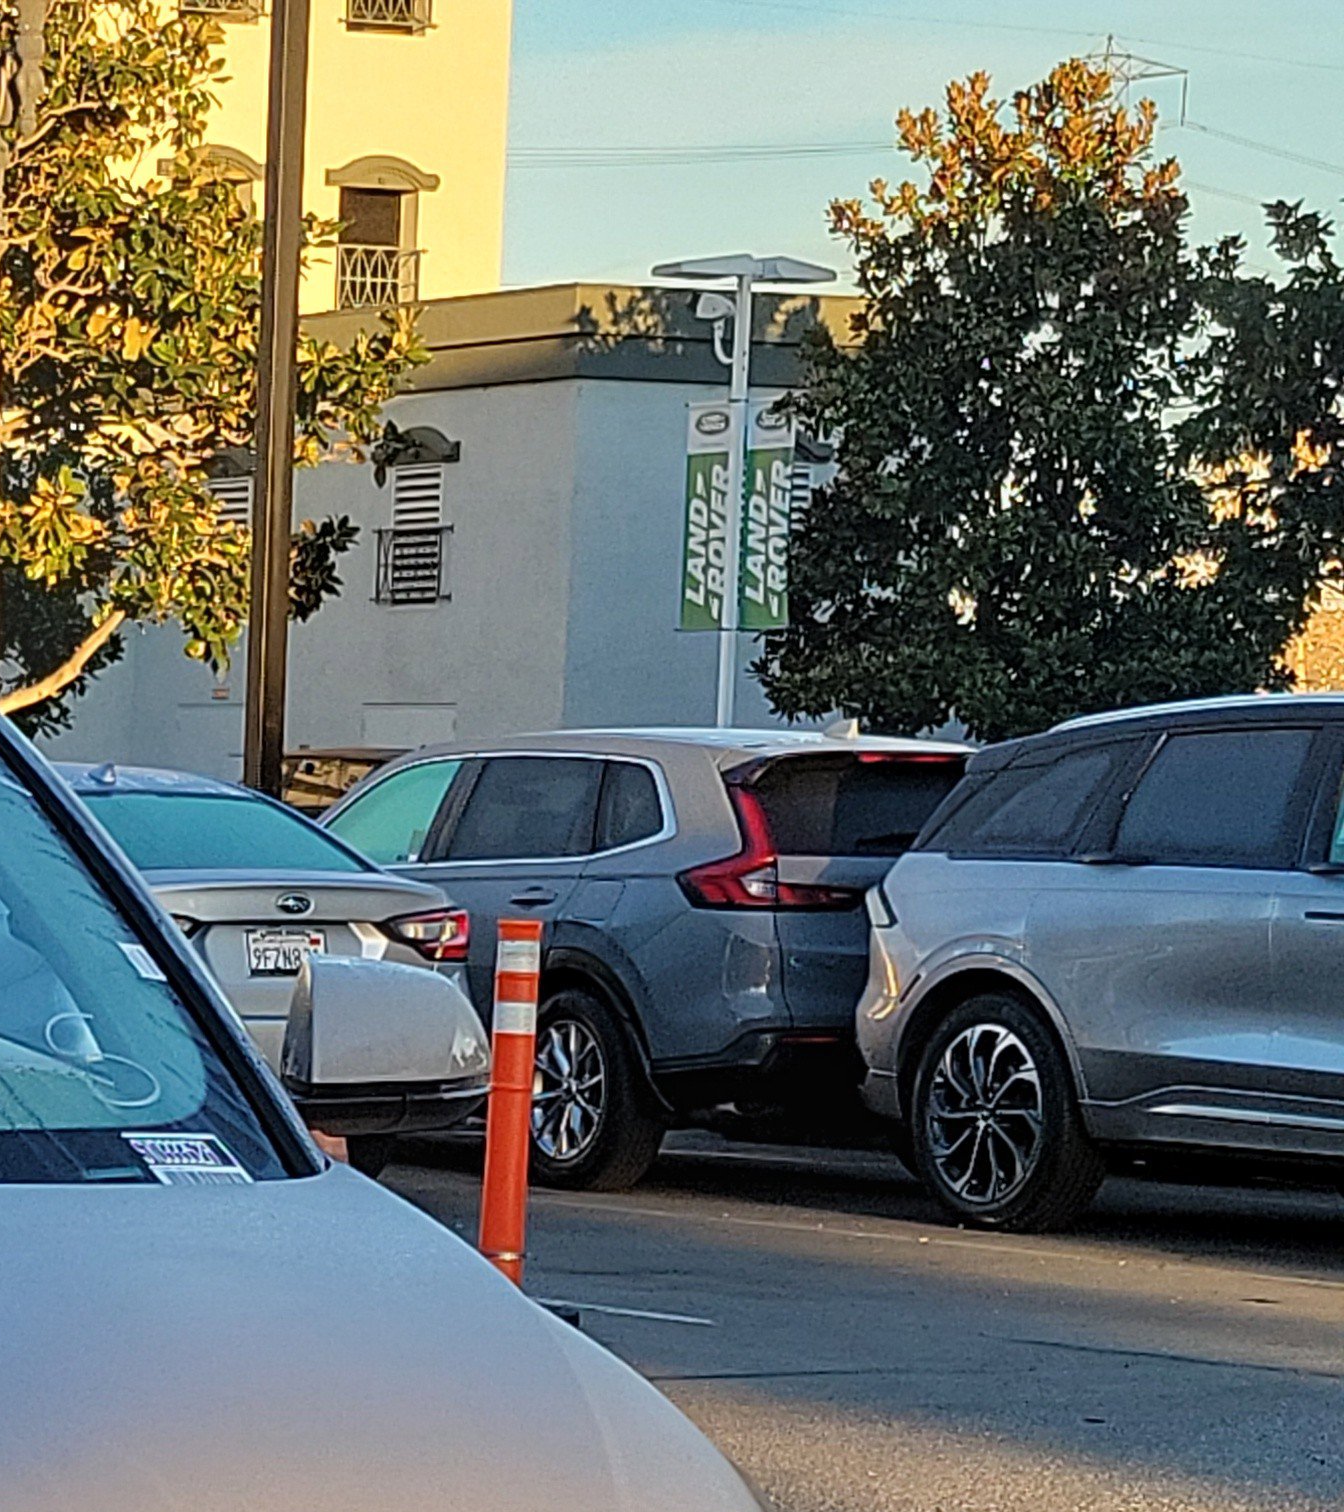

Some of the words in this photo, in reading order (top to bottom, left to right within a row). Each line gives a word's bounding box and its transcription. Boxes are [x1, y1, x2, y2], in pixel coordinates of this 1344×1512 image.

[687, 498, 708, 606] LAND
[709, 464, 729, 595] ROVER
[746, 494, 768, 604] LAND
[769, 460, 790, 591] ROVER
